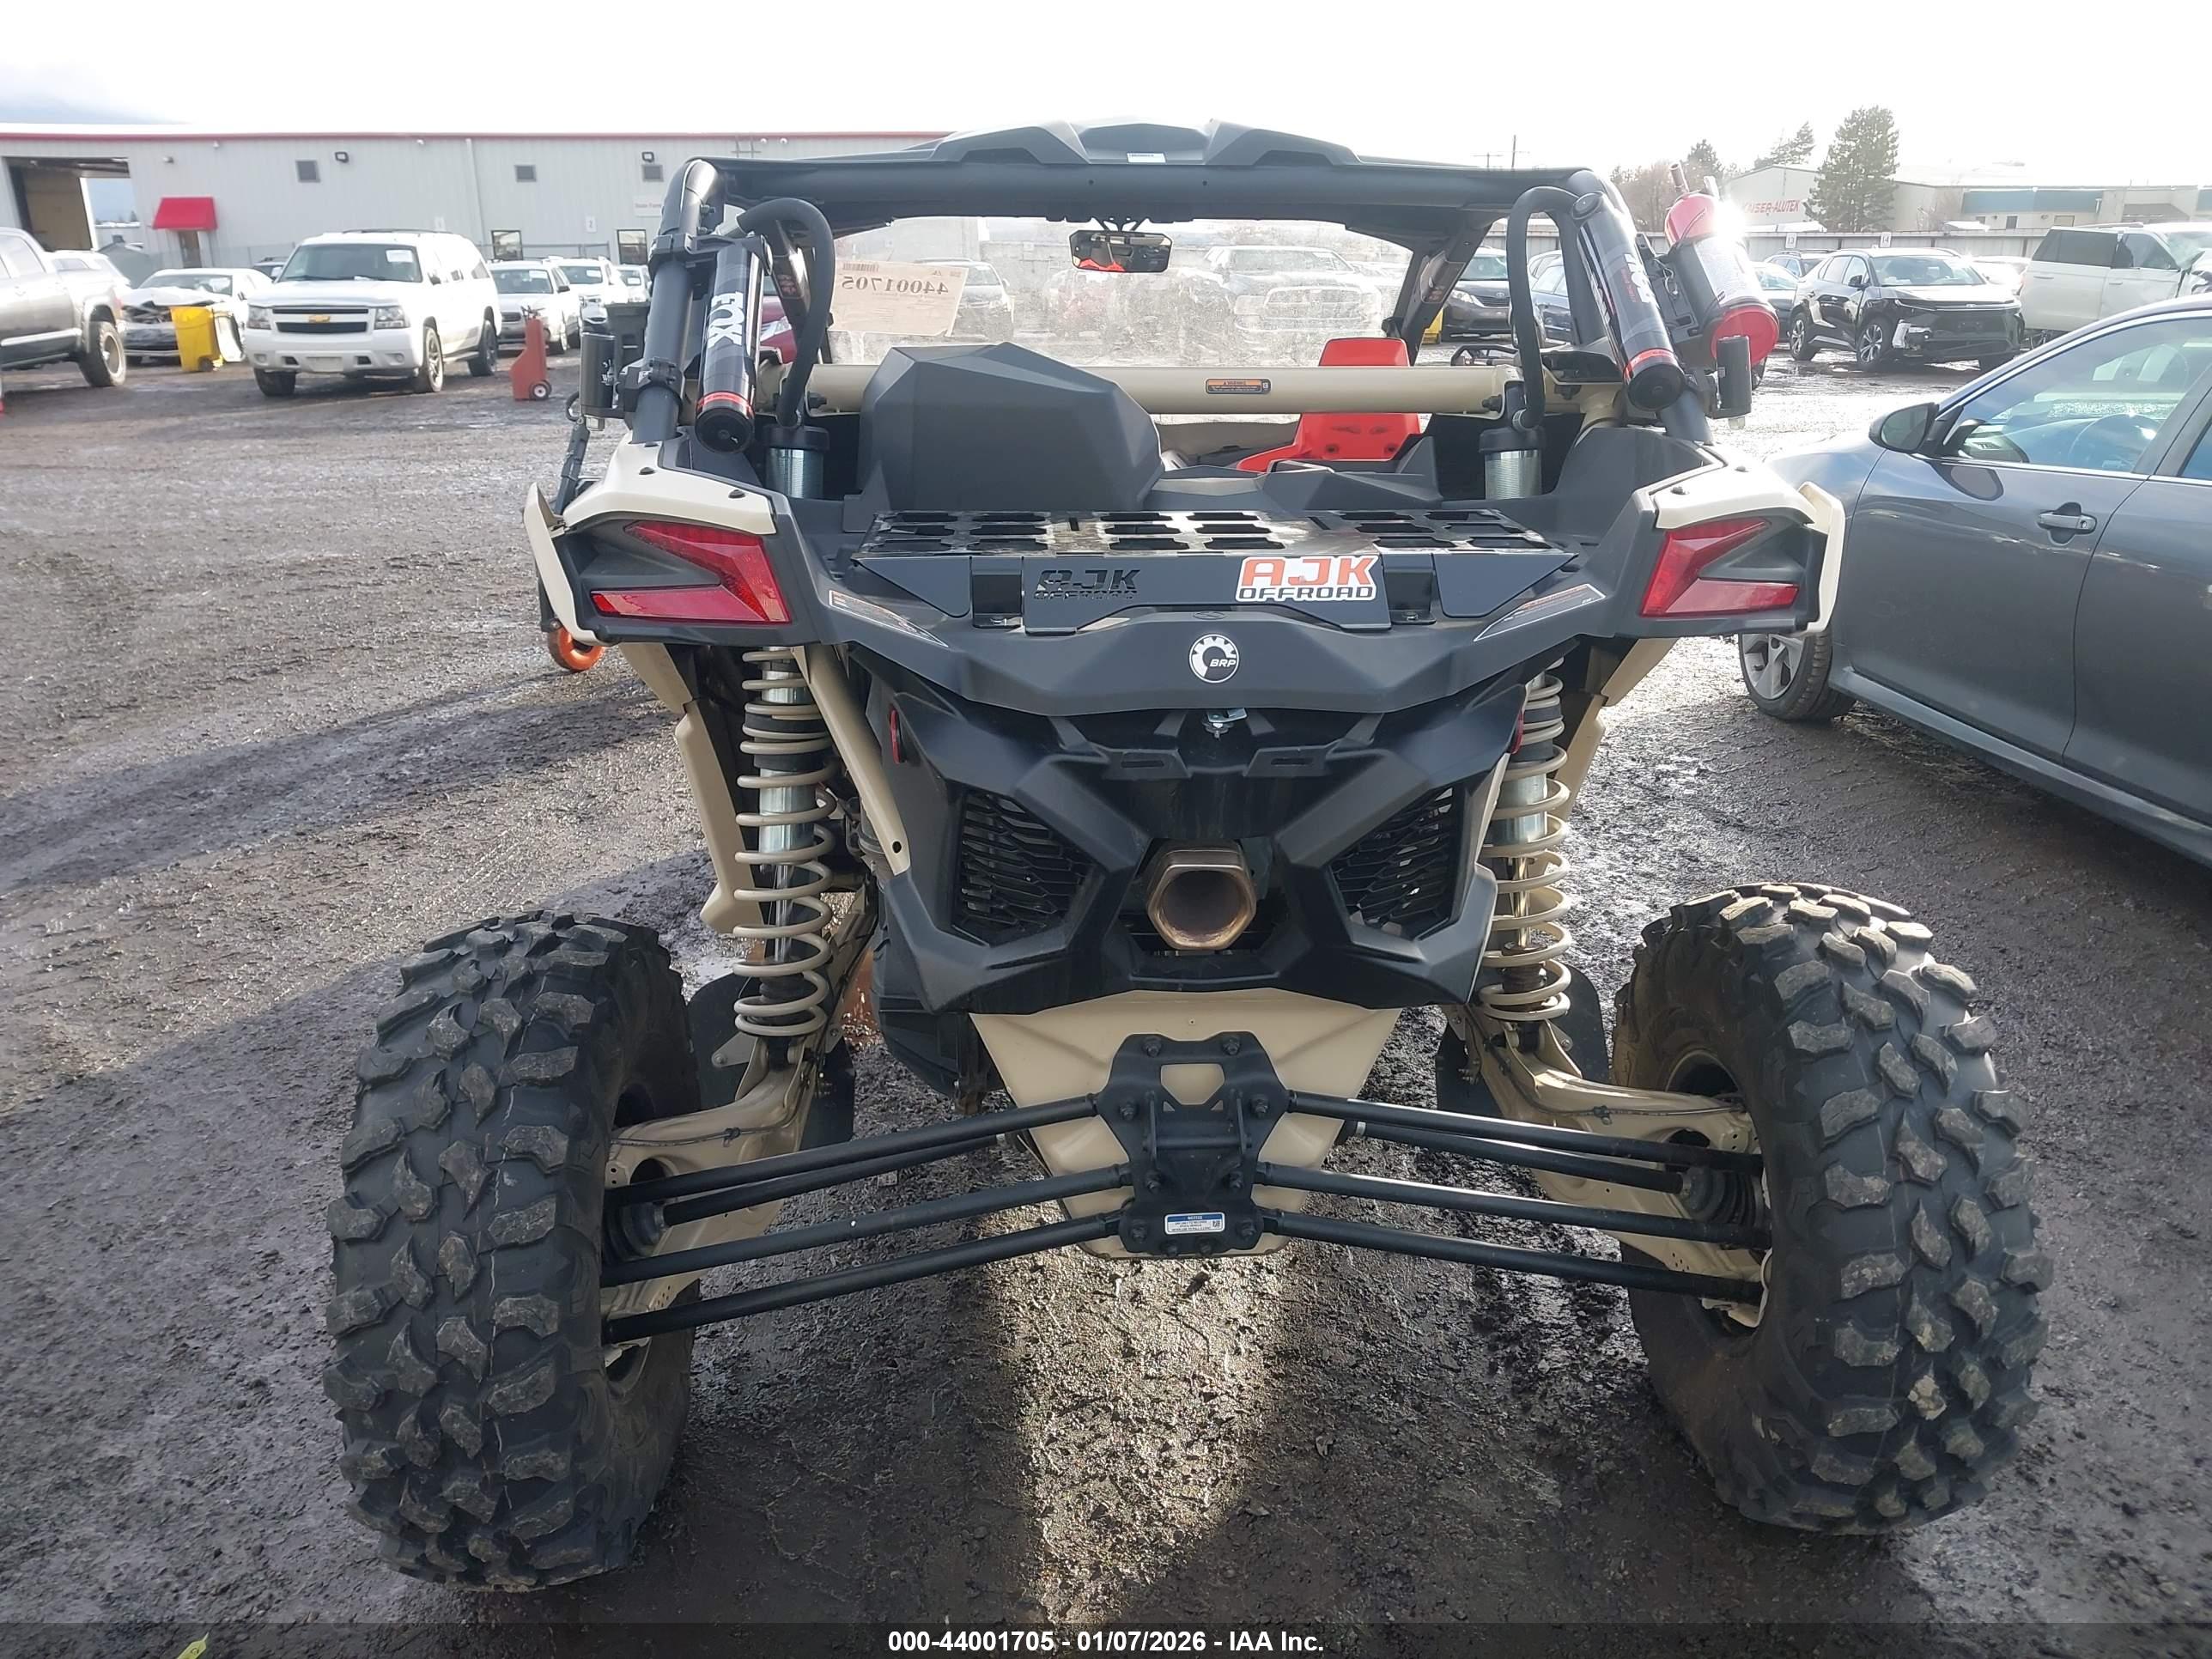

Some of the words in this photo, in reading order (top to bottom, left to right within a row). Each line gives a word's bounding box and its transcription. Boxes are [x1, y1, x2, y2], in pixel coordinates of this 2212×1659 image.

[707, 291, 744, 349] FOX
[1036, 570, 1140, 590] AJK
[1242, 558, 1374, 586] AJK
[1239, 586, 1373, 599] OFFROAD
[1210, 659, 1237, 667] BRP
